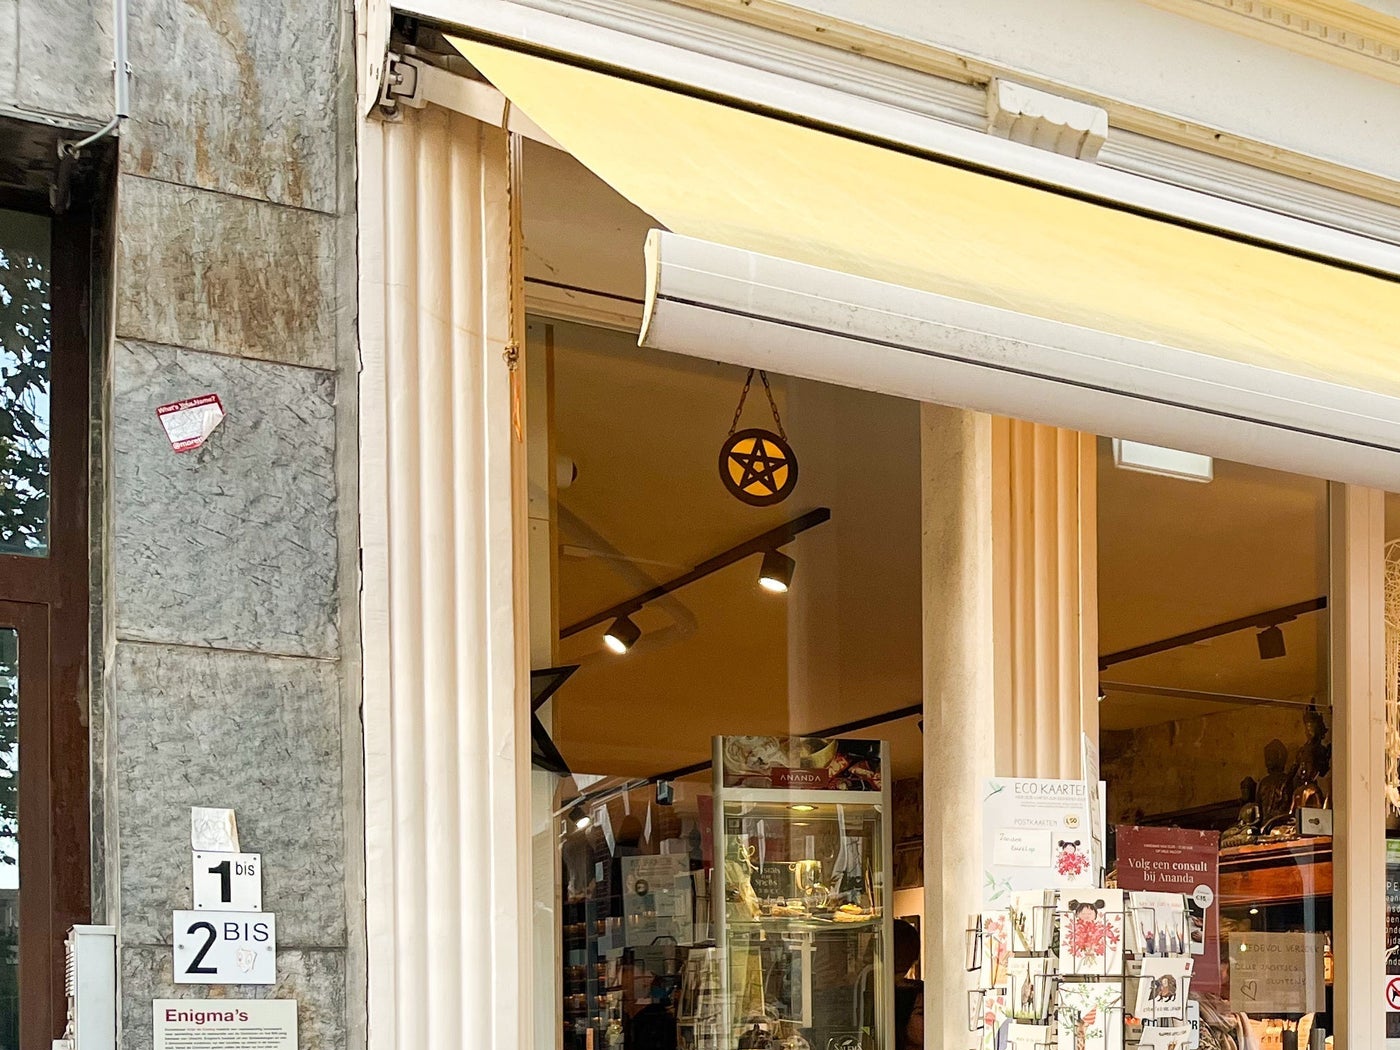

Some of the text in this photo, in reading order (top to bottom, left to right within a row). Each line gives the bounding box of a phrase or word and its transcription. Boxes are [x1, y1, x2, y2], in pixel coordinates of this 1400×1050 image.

[780, 773, 822, 782] ANANDA
[1014, 783, 1037, 794] ECO
[1128, 858, 1207, 872] Volg een consult
[208, 860, 255, 903] 1 bis
[1143, 871, 1194, 883] bij Ananda
[185, 921, 269, 974] 2 BIS
[165, 1008, 249, 1025] Enigma's
